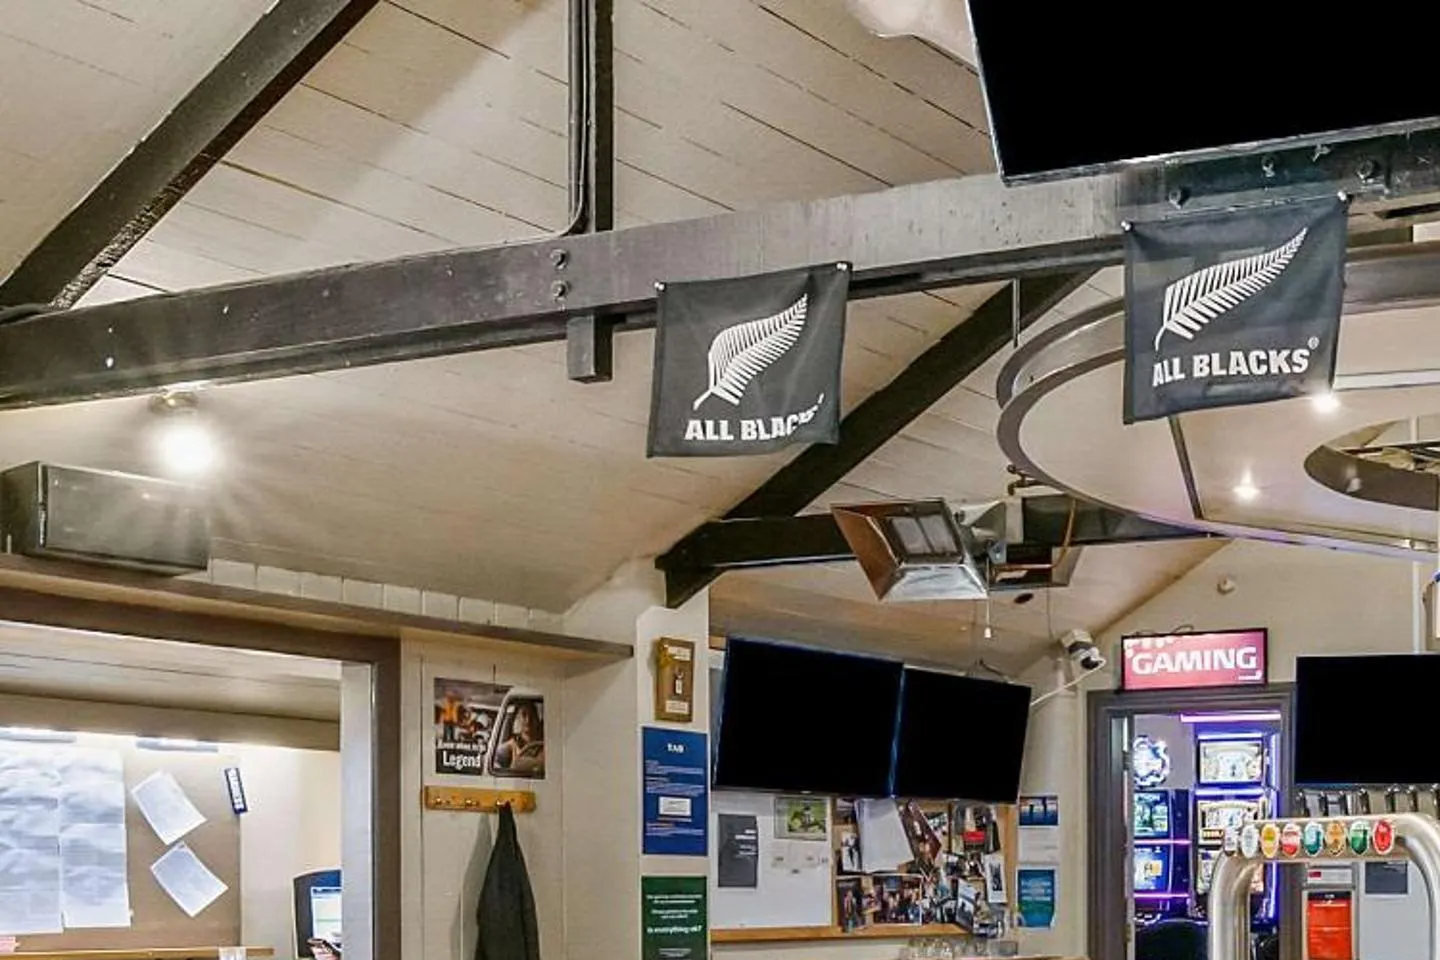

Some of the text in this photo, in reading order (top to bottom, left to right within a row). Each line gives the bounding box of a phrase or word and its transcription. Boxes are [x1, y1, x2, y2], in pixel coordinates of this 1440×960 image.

[1153, 348, 1311, 387] ALL BLACKS
[684, 402, 824, 441] ALL BLAC
[1132, 646, 1257, 675] GAMING
[443, 750, 481, 770] Legend
